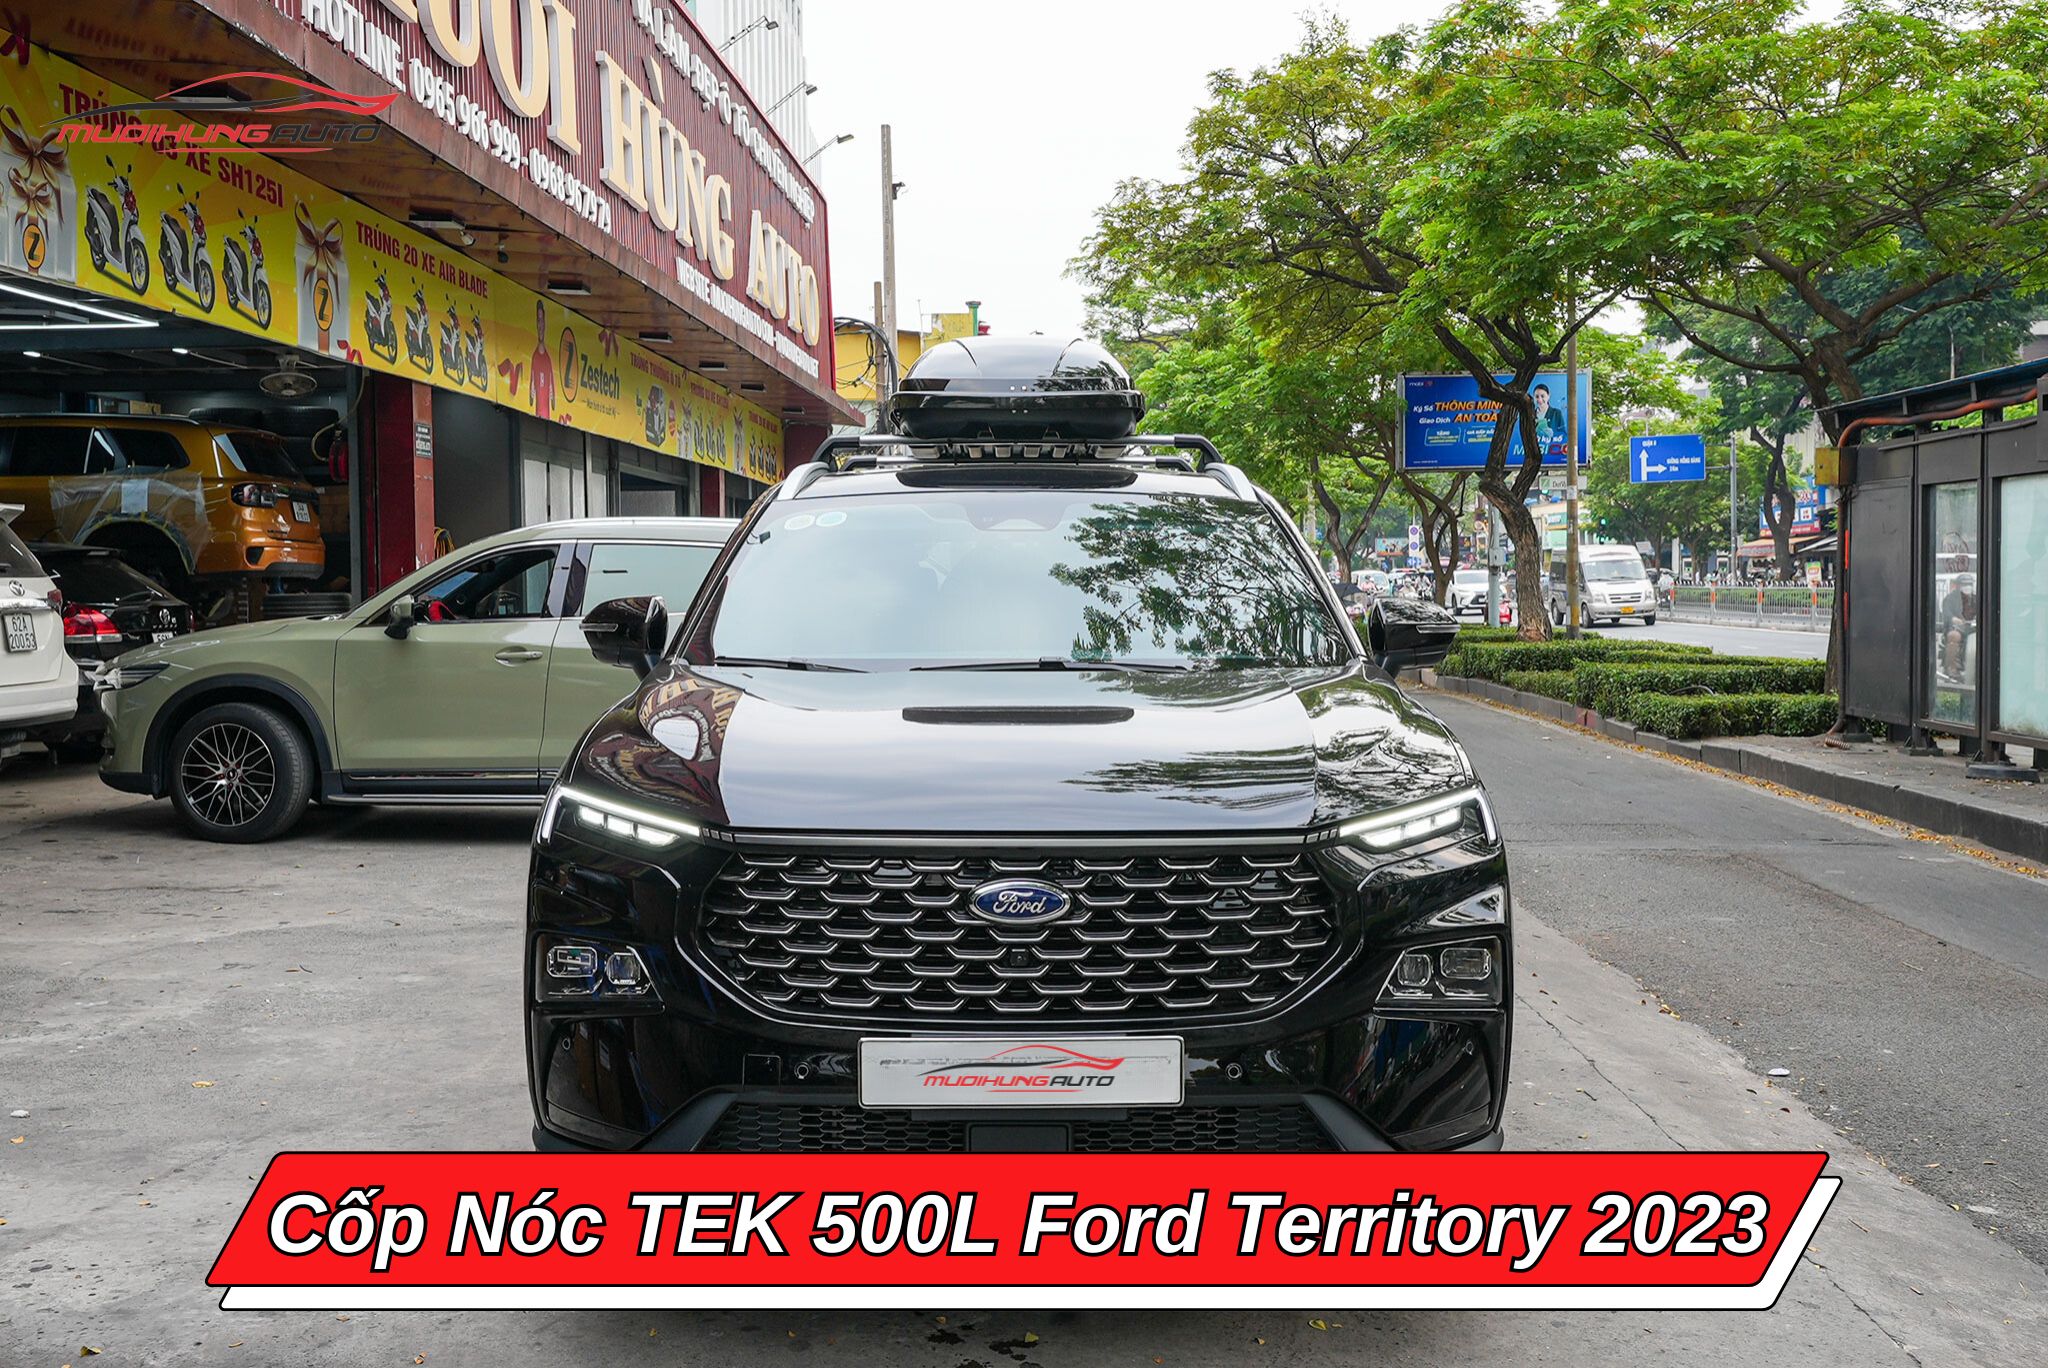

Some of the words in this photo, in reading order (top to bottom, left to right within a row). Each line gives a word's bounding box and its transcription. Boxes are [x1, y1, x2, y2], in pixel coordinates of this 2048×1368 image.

[409, 57, 456, 126] 0965
[596, 51, 735, 280] HÙNG
[746, 210, 820, 347] AUTO
[356, 220, 400, 260] TRÚNG
[403, 243, 418, 268] 20
[421, 251, 436, 276] XE
[439, 260, 456, 285] AIR
[459, 268, 488, 299] BLADE
[580, 353, 620, 401] Zestech
[1435, 399, 1475, 412] THÔNG
[1454, 413, 1472, 423] AN
[12, 616, 28, 632] 62A
[993, 889, 1046, 915] Ford
